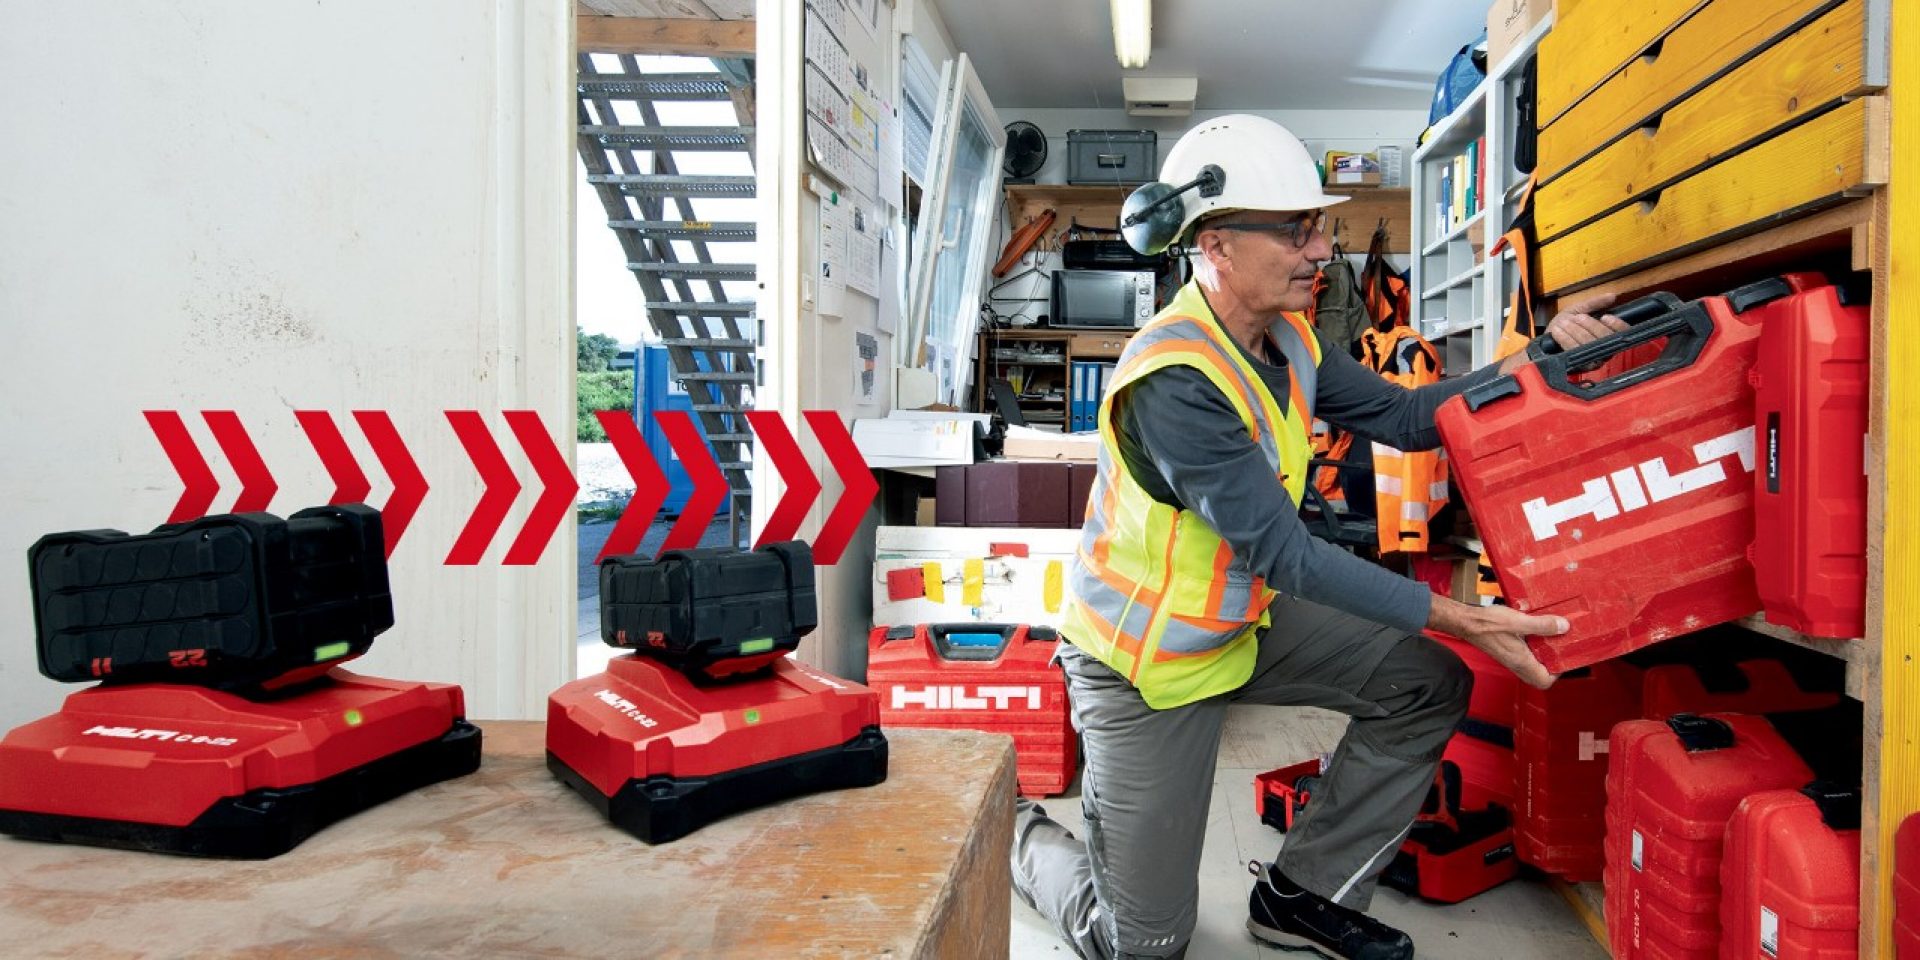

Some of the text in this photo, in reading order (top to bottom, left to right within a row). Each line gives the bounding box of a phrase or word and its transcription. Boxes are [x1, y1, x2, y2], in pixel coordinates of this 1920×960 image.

[1521, 425, 1756, 542] HILT
[892, 685, 1041, 710] HILTI
[82, 725, 180, 741] HILTI
